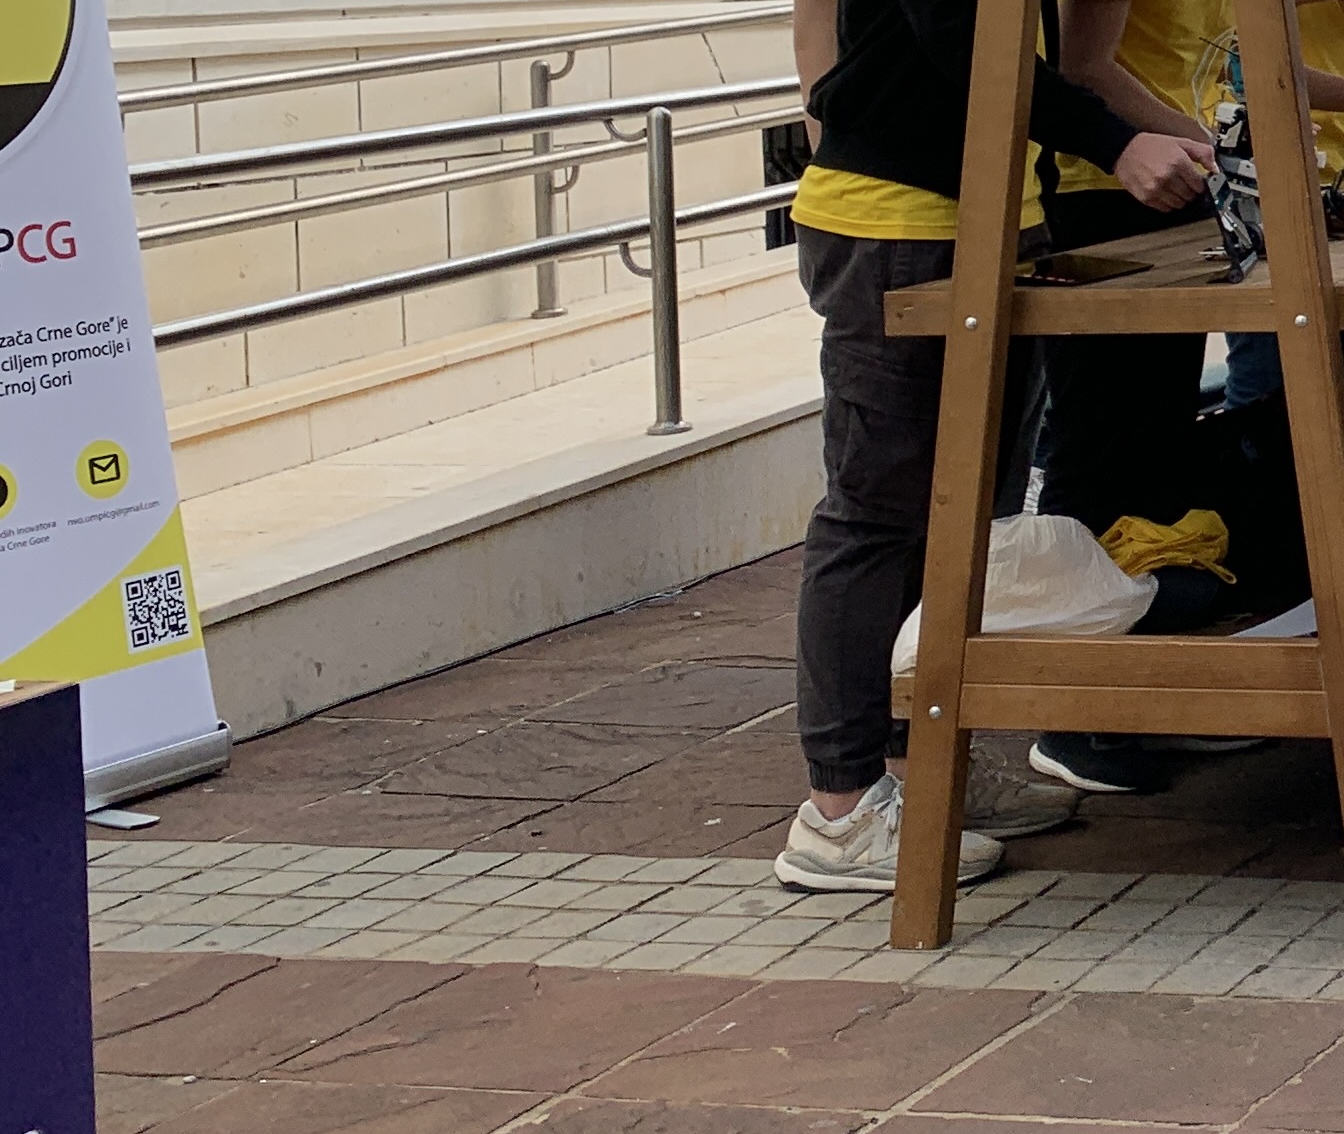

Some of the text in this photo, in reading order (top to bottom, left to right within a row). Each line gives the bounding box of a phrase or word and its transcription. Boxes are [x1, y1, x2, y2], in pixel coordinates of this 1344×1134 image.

[36, 326, 73, 342] Crne
[116, 315, 128, 334] je
[1, 337, 131, 373] ciljem promocije i
[39, 370, 73, 390] Gori
